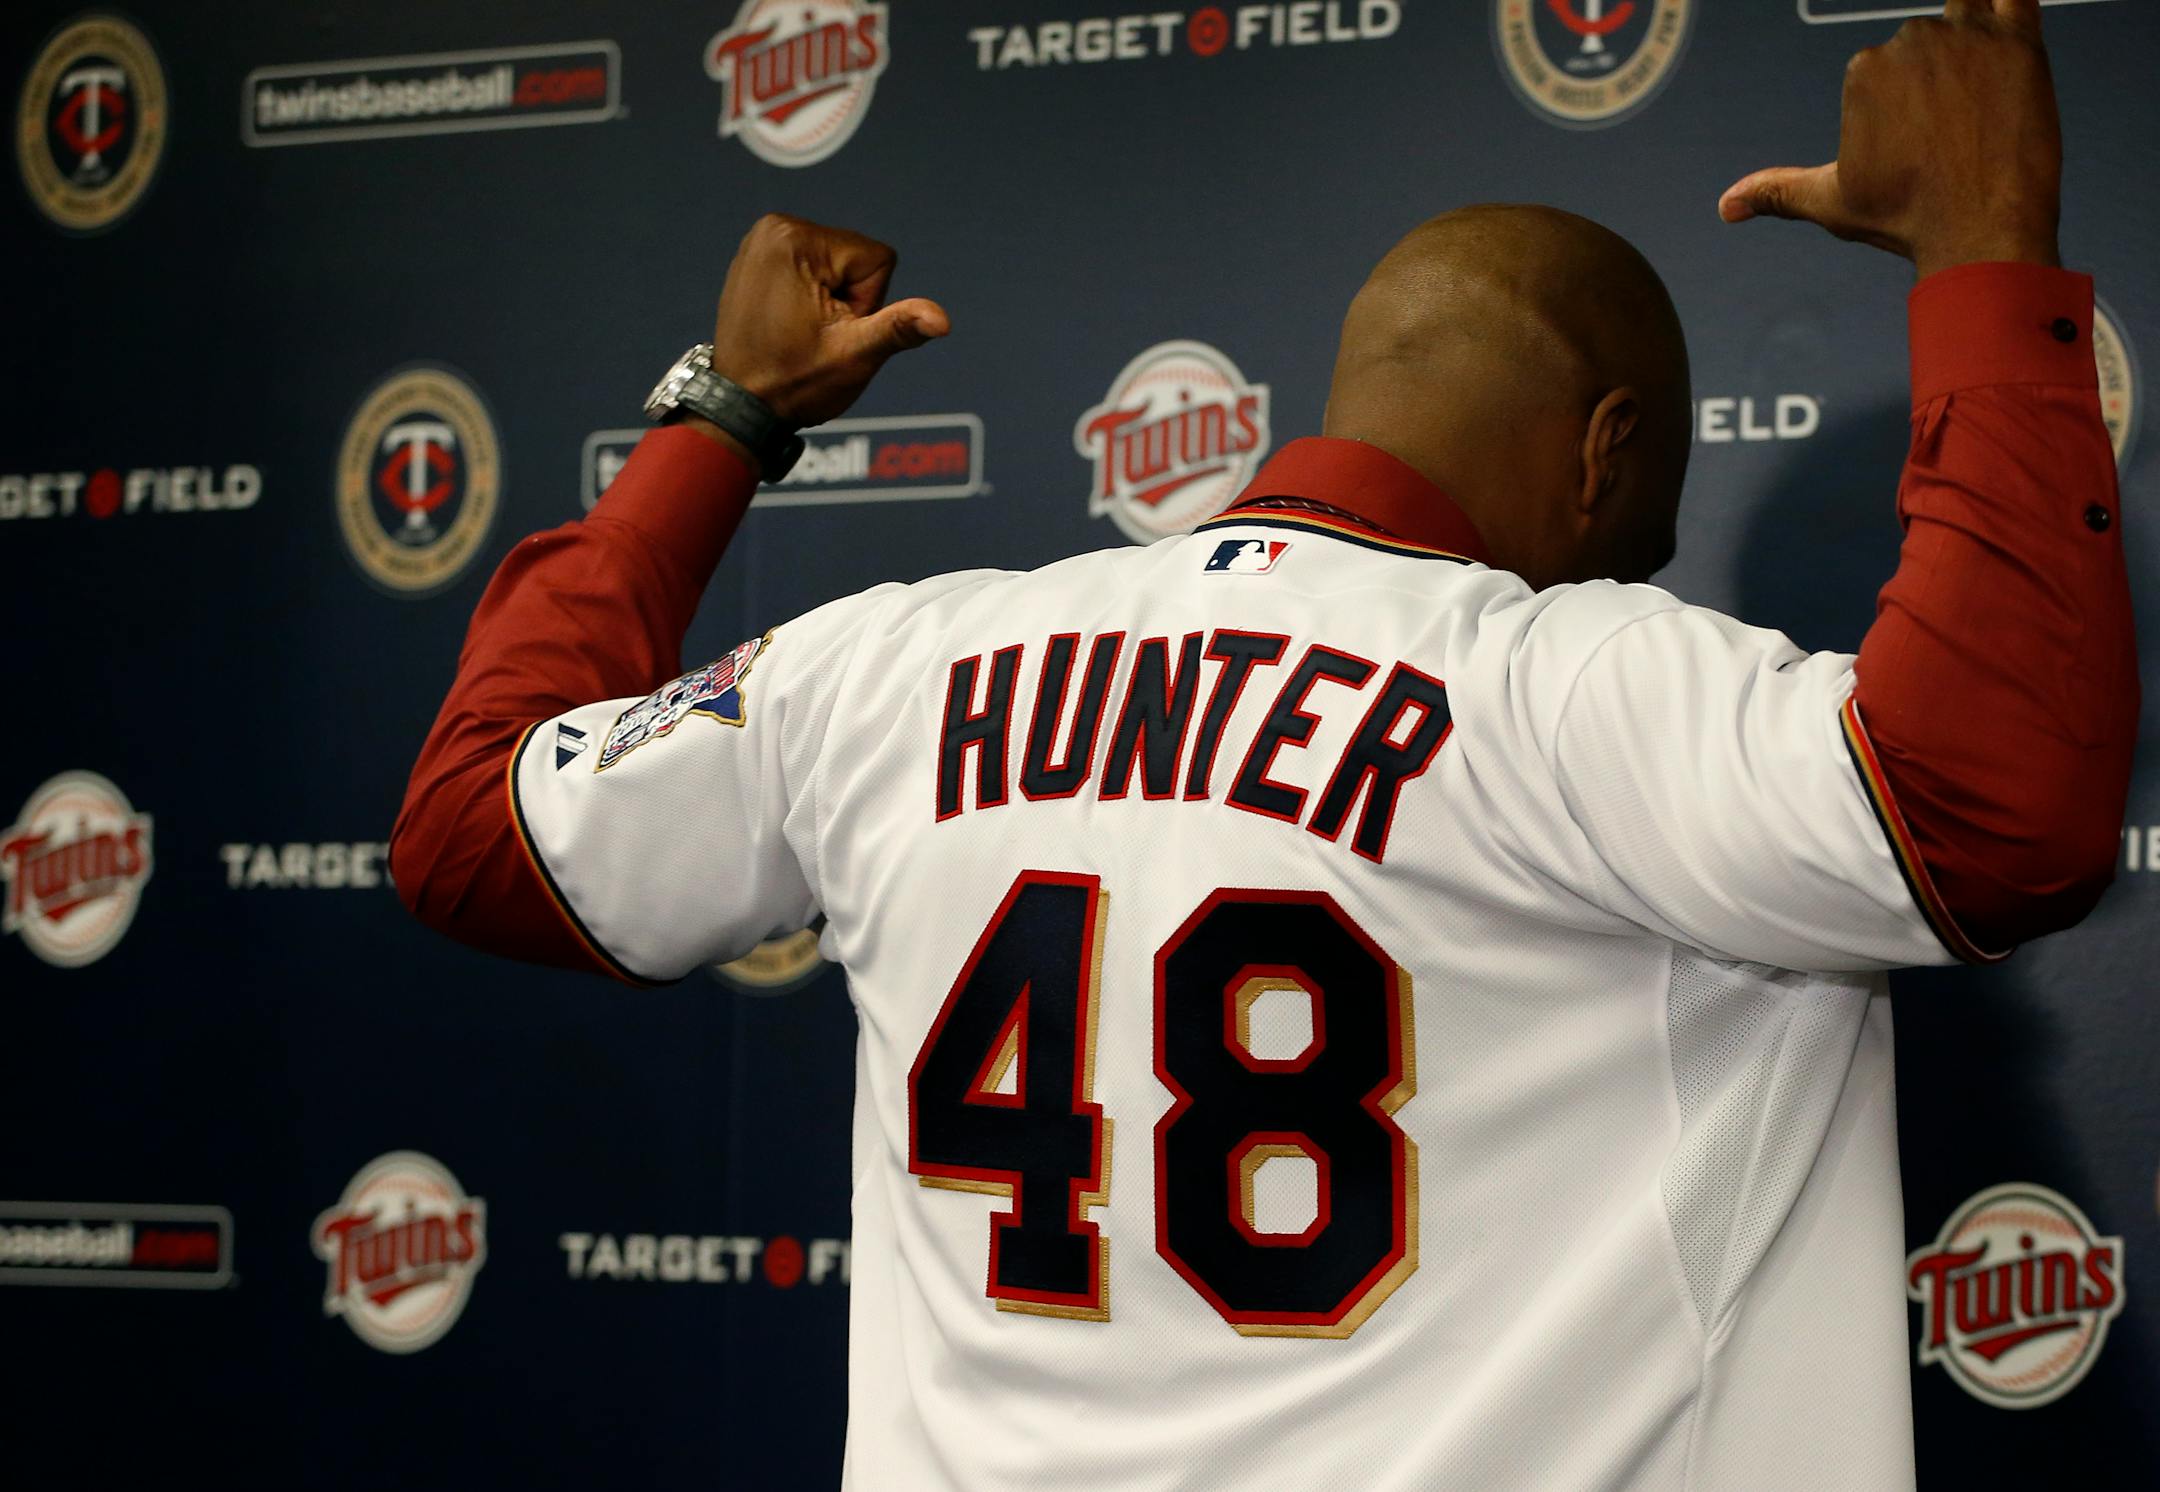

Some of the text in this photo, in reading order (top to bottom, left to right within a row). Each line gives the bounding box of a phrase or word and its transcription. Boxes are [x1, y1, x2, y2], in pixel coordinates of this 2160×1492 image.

[715, 10, 879, 121] Twins
[967, 0, 1401, 70] TARGET FIELD
[256, 63, 606, 127] twinsbaseball.com
[1085, 389, 1260, 499] Twins
[1692, 394, 1820, 443] ELD
[122, 463, 262, 515] FIELD
[935, 629, 1454, 865] HUNTER
[1, 817, 146, 917] Twins
[908, 869, 1420, 1341] 48
[0, 1219, 219, 1267] aseball.com
[322, 1200, 478, 1298] Twins
[558, 1232, 763, 1284] TARGET
[1908, 1233, 2116, 1350] Twins
